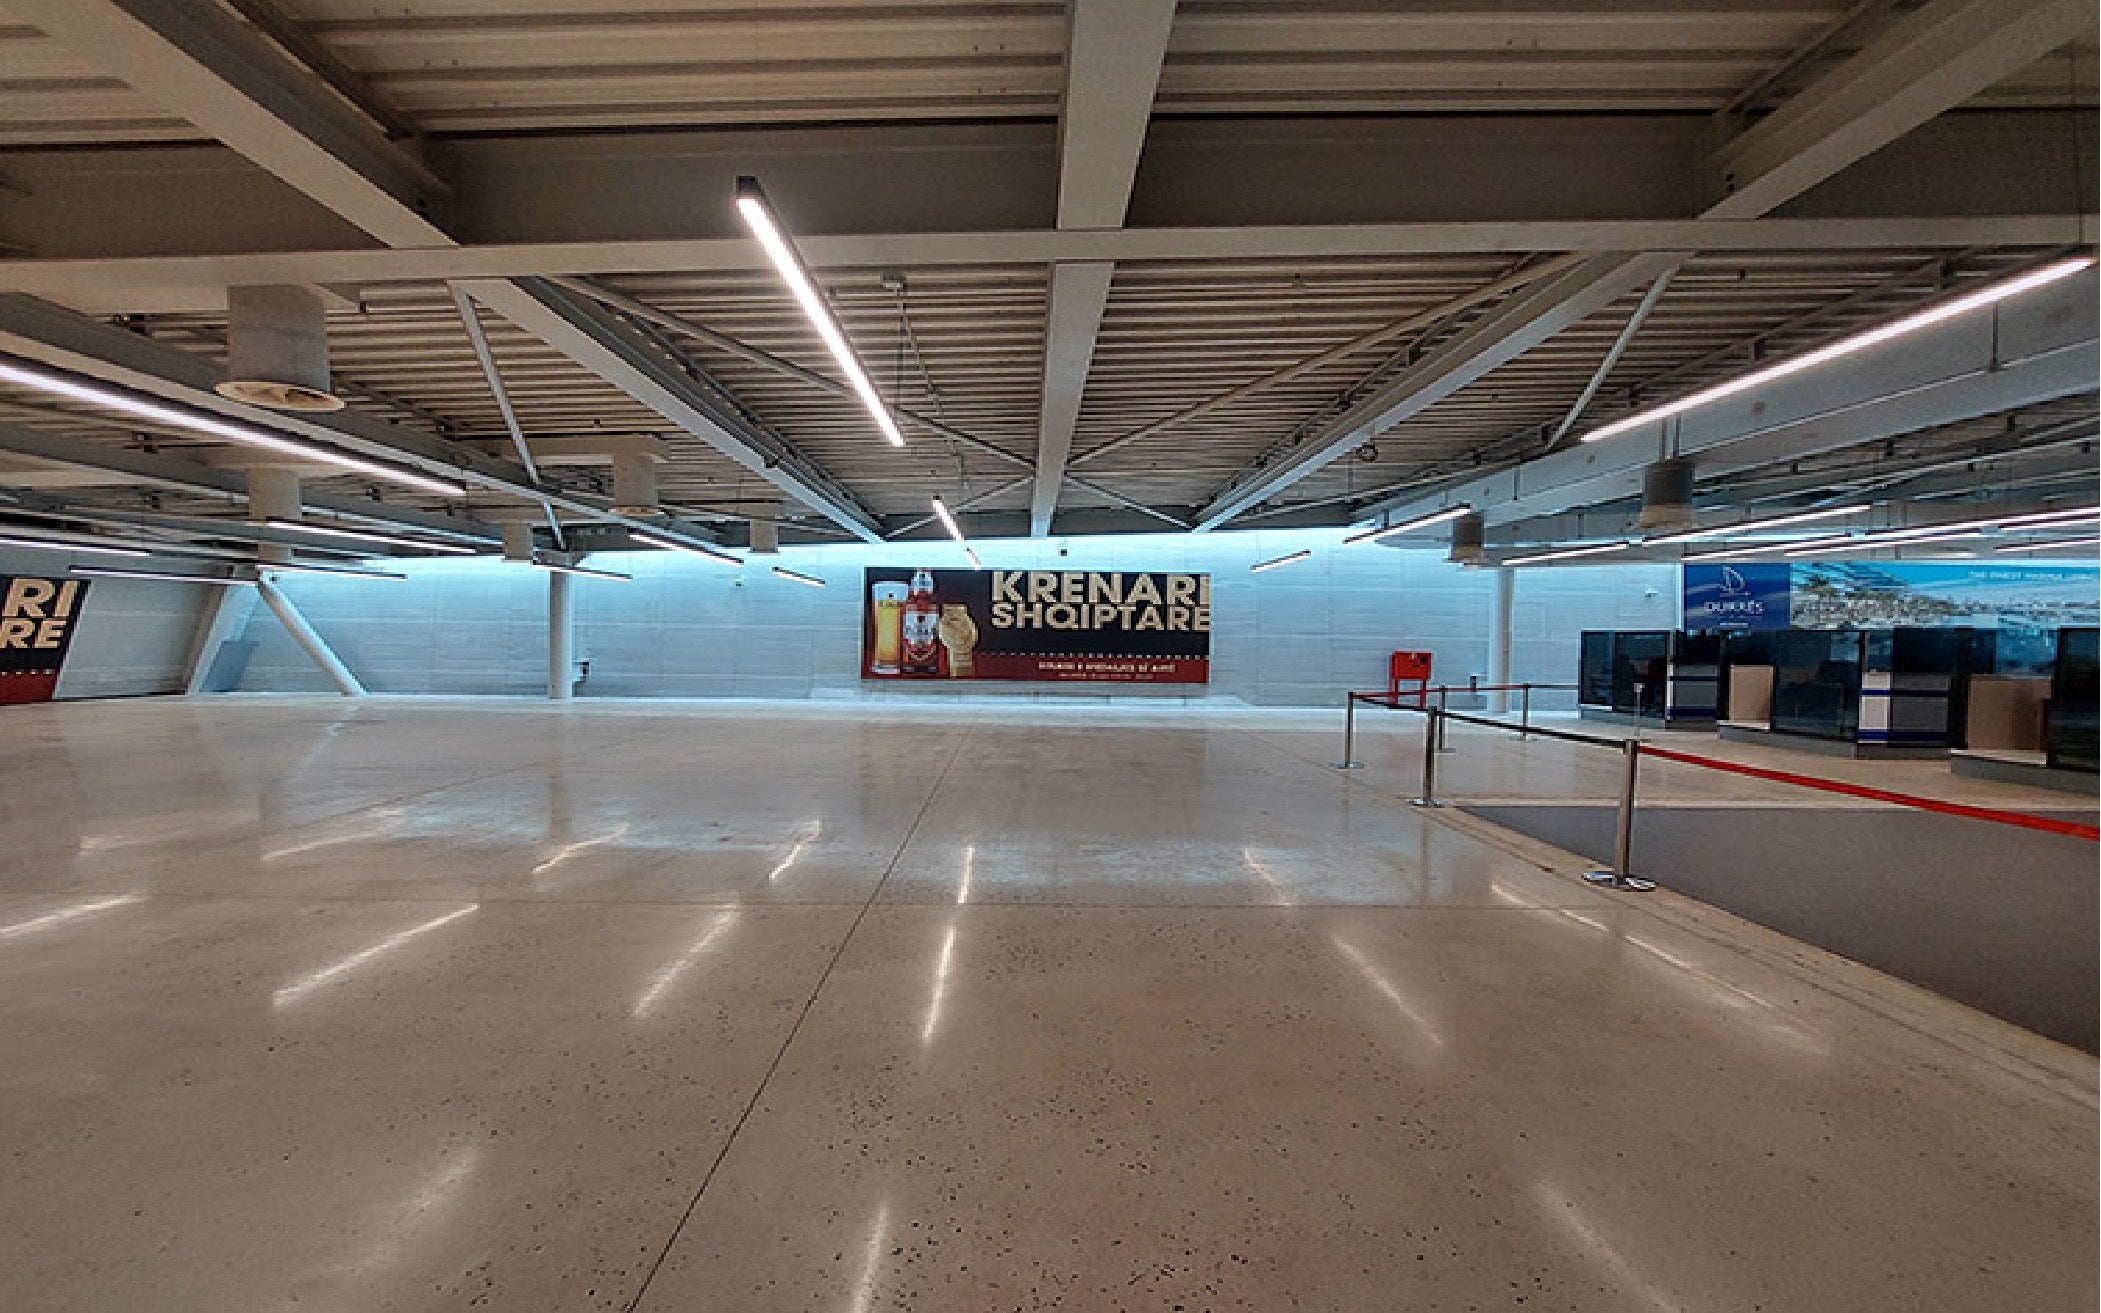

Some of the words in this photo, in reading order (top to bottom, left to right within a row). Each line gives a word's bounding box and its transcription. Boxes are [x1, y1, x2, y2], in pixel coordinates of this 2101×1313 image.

[2, 578, 80, 617] RI
[992, 571, 1210, 605] KRENARI
[991, 603, 1210, 631] SHQIPTARE
